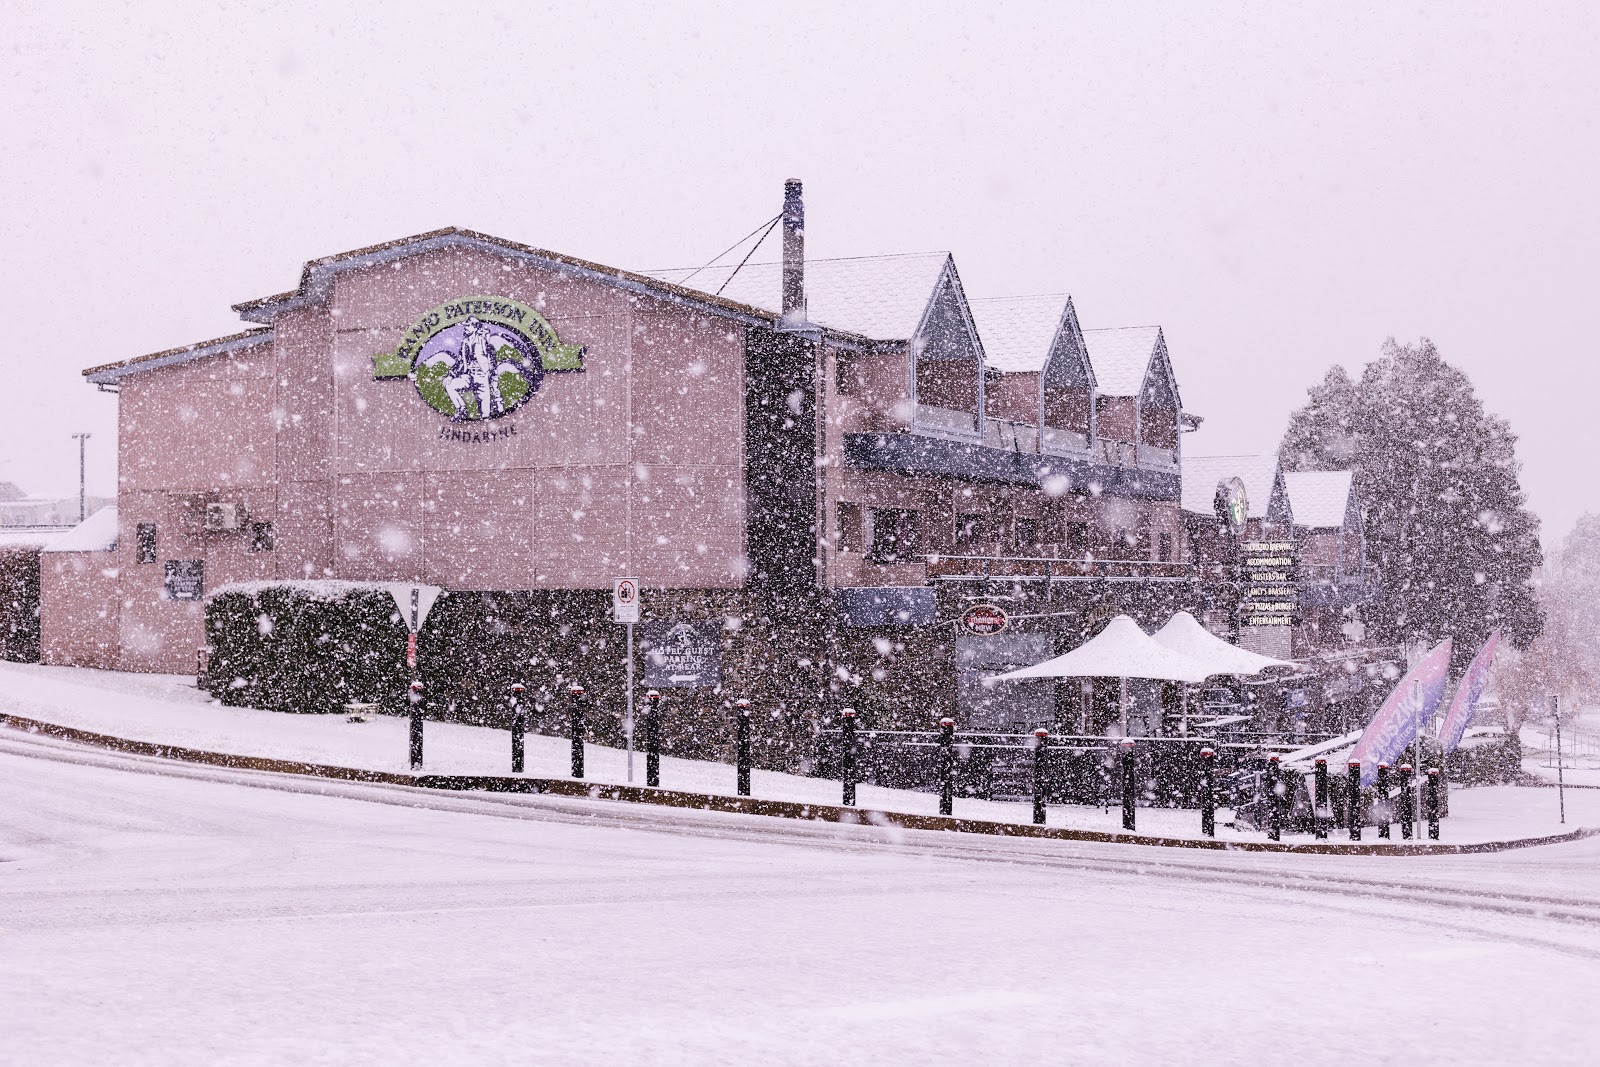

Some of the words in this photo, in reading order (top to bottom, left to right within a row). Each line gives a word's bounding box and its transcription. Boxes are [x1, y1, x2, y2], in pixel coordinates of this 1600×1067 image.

[397, 312, 440, 359] BANJO
[444, 301, 527, 323] PATERSON
[529, 318, 557, 352] INN
[439, 423, 518, 444] JINDABYNE
[1247, 557, 1292, 566] ACCOMMODATION
[1252, 572, 1275, 581] MUSTERS
[1276, 572, 1287, 581] BAR
[1249, 616, 1293, 625] ENTERTAINMENT
[652, 647, 681, 655] HOTEL
[685, 647, 714, 655] GUEST
[664, 655, 702, 664] PARKING
